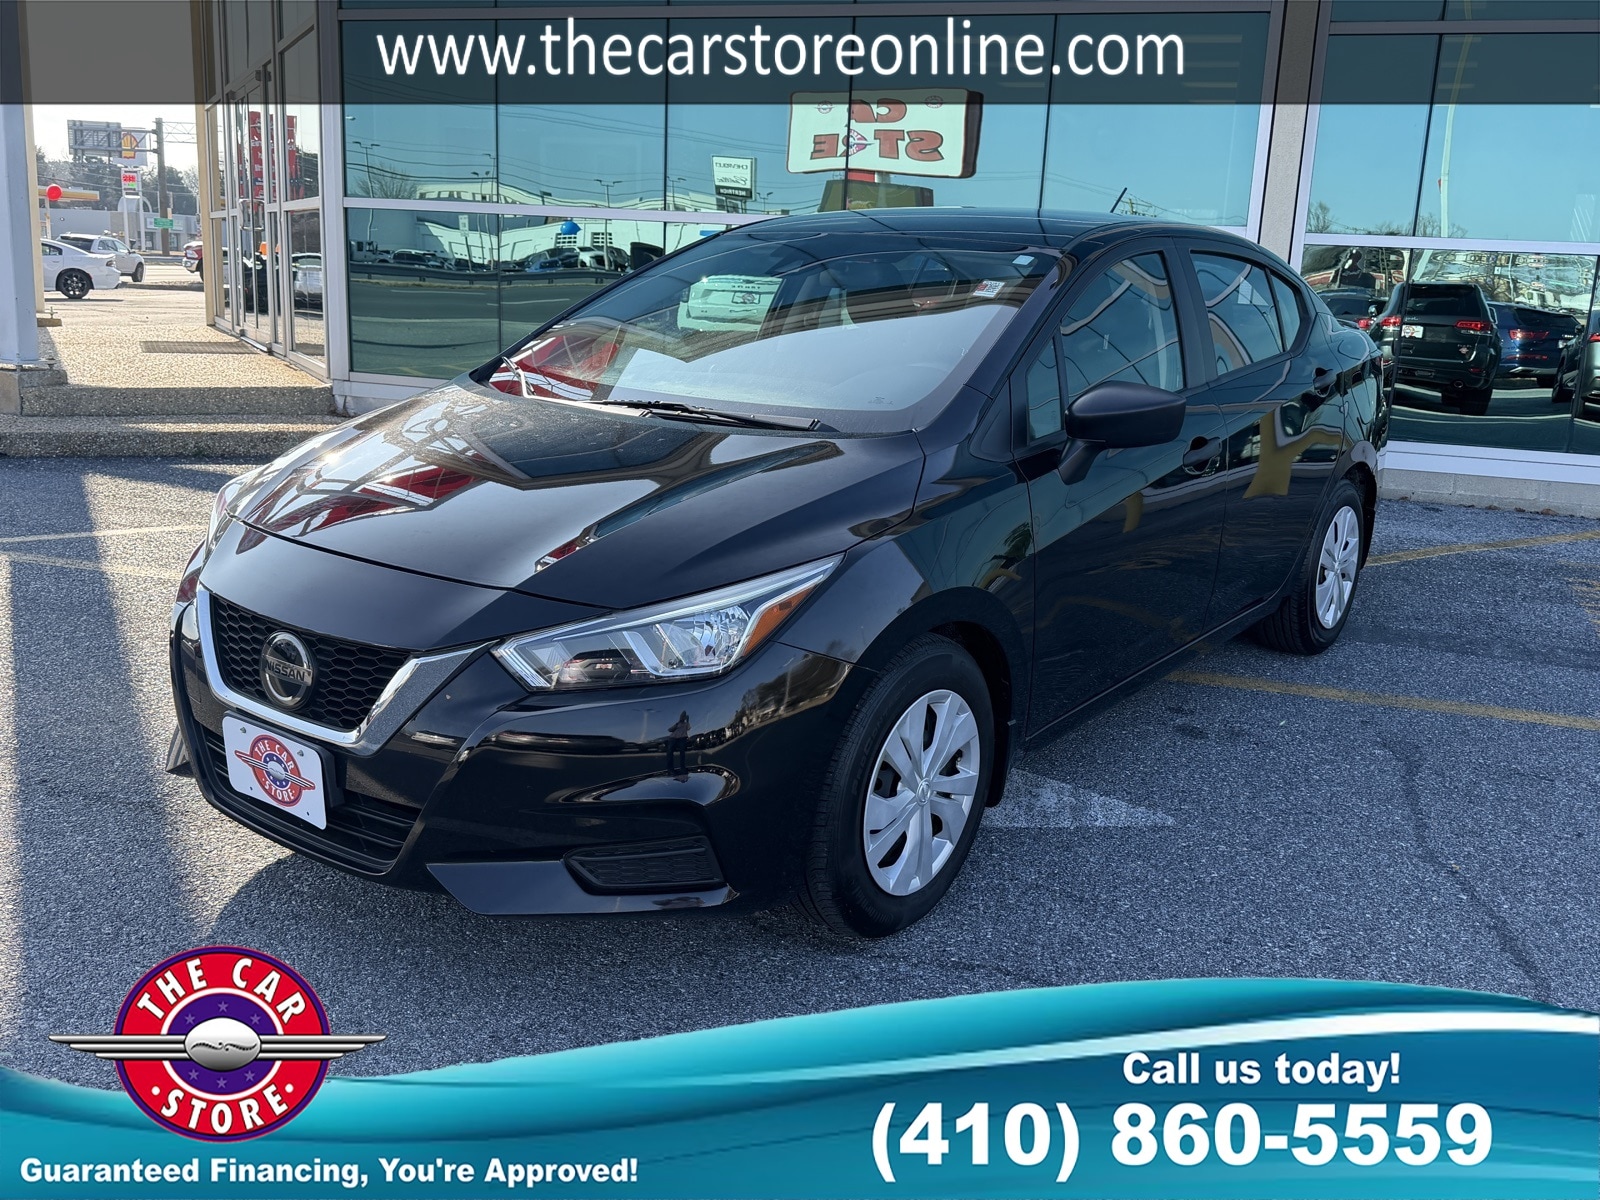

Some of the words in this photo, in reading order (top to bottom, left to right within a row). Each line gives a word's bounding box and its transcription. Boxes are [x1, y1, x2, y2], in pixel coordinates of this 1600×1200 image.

[265, 660, 305, 682] NISSAN
[254, 740, 271, 757] THE
[275, 741, 296, 771] CAR
[263, 781, 295, 802] STORE
